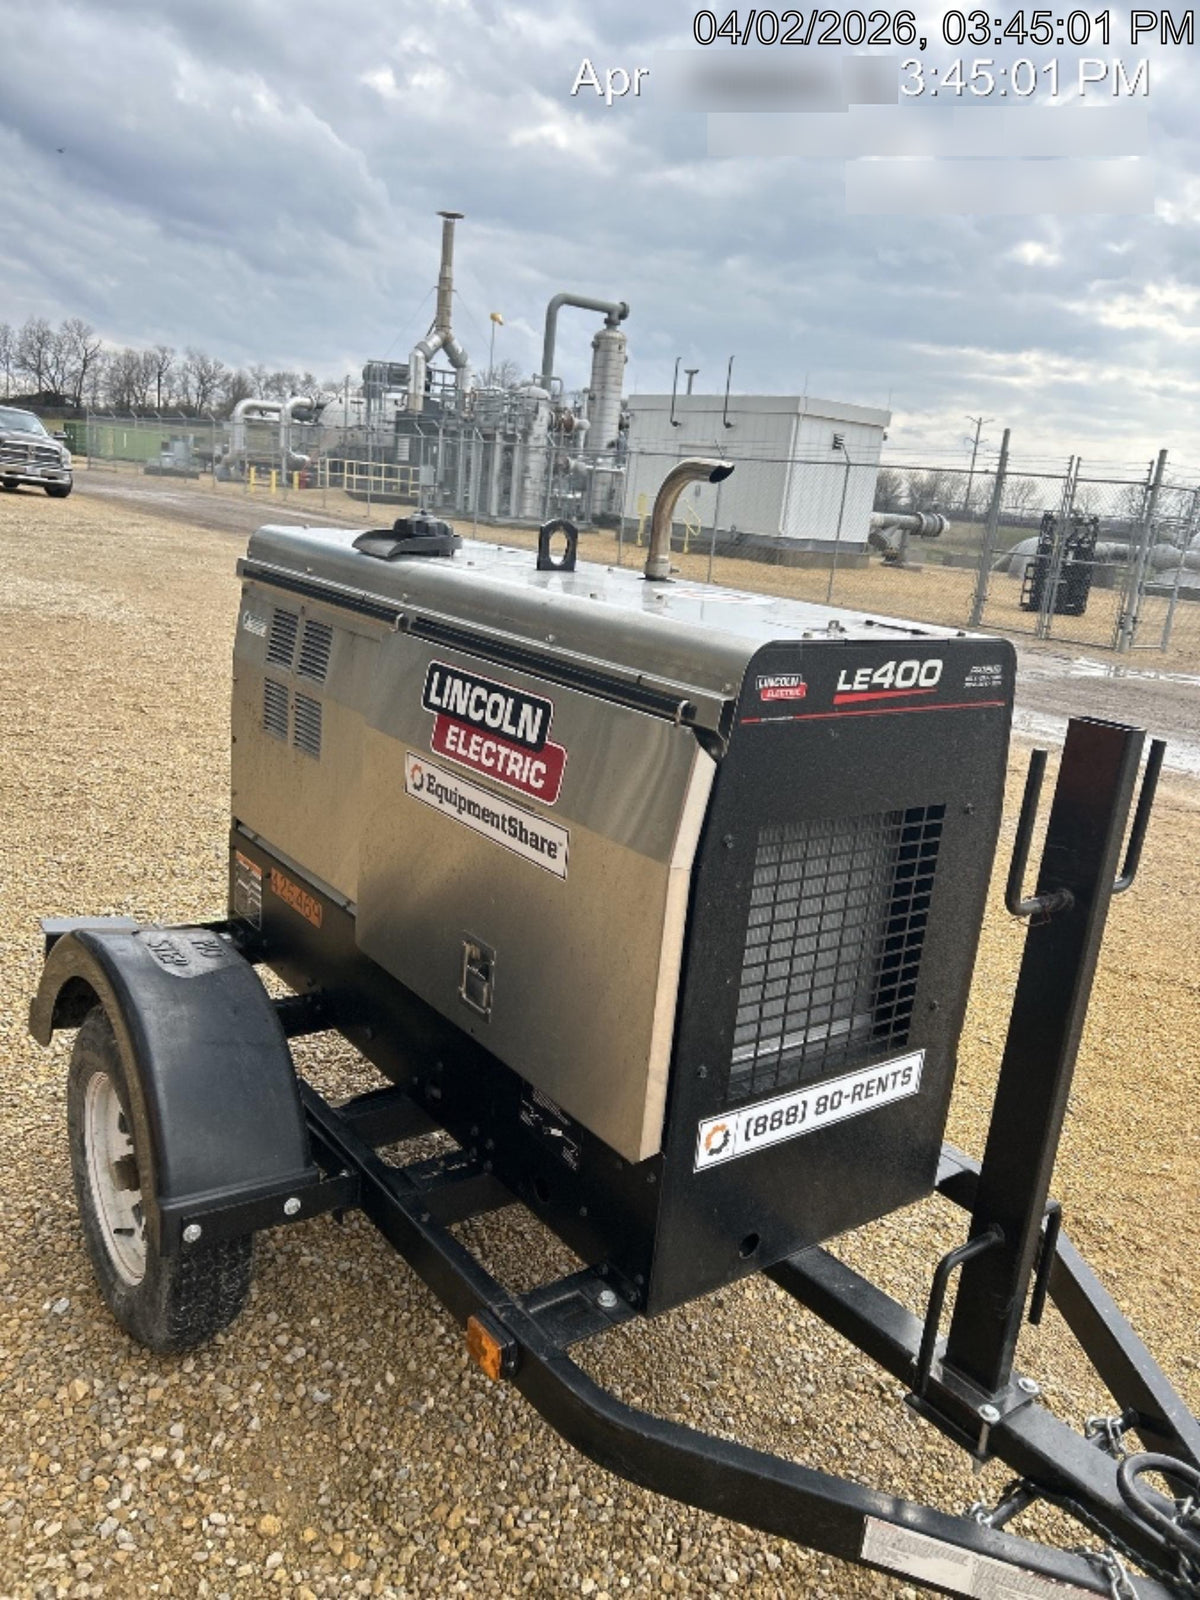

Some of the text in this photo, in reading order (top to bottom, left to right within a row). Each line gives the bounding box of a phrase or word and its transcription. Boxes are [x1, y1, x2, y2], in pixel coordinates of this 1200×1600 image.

[429, 671, 543, 744] LINCOLN
[757, 676, 800, 688] LINCOLN
[837, 659, 943, 691] LE400
[445, 725, 547, 789] ELECTRIC
[426, 773, 558, 859] EquipmentShare
[744, 1066, 913, 1141] (888) 80-RENTS
